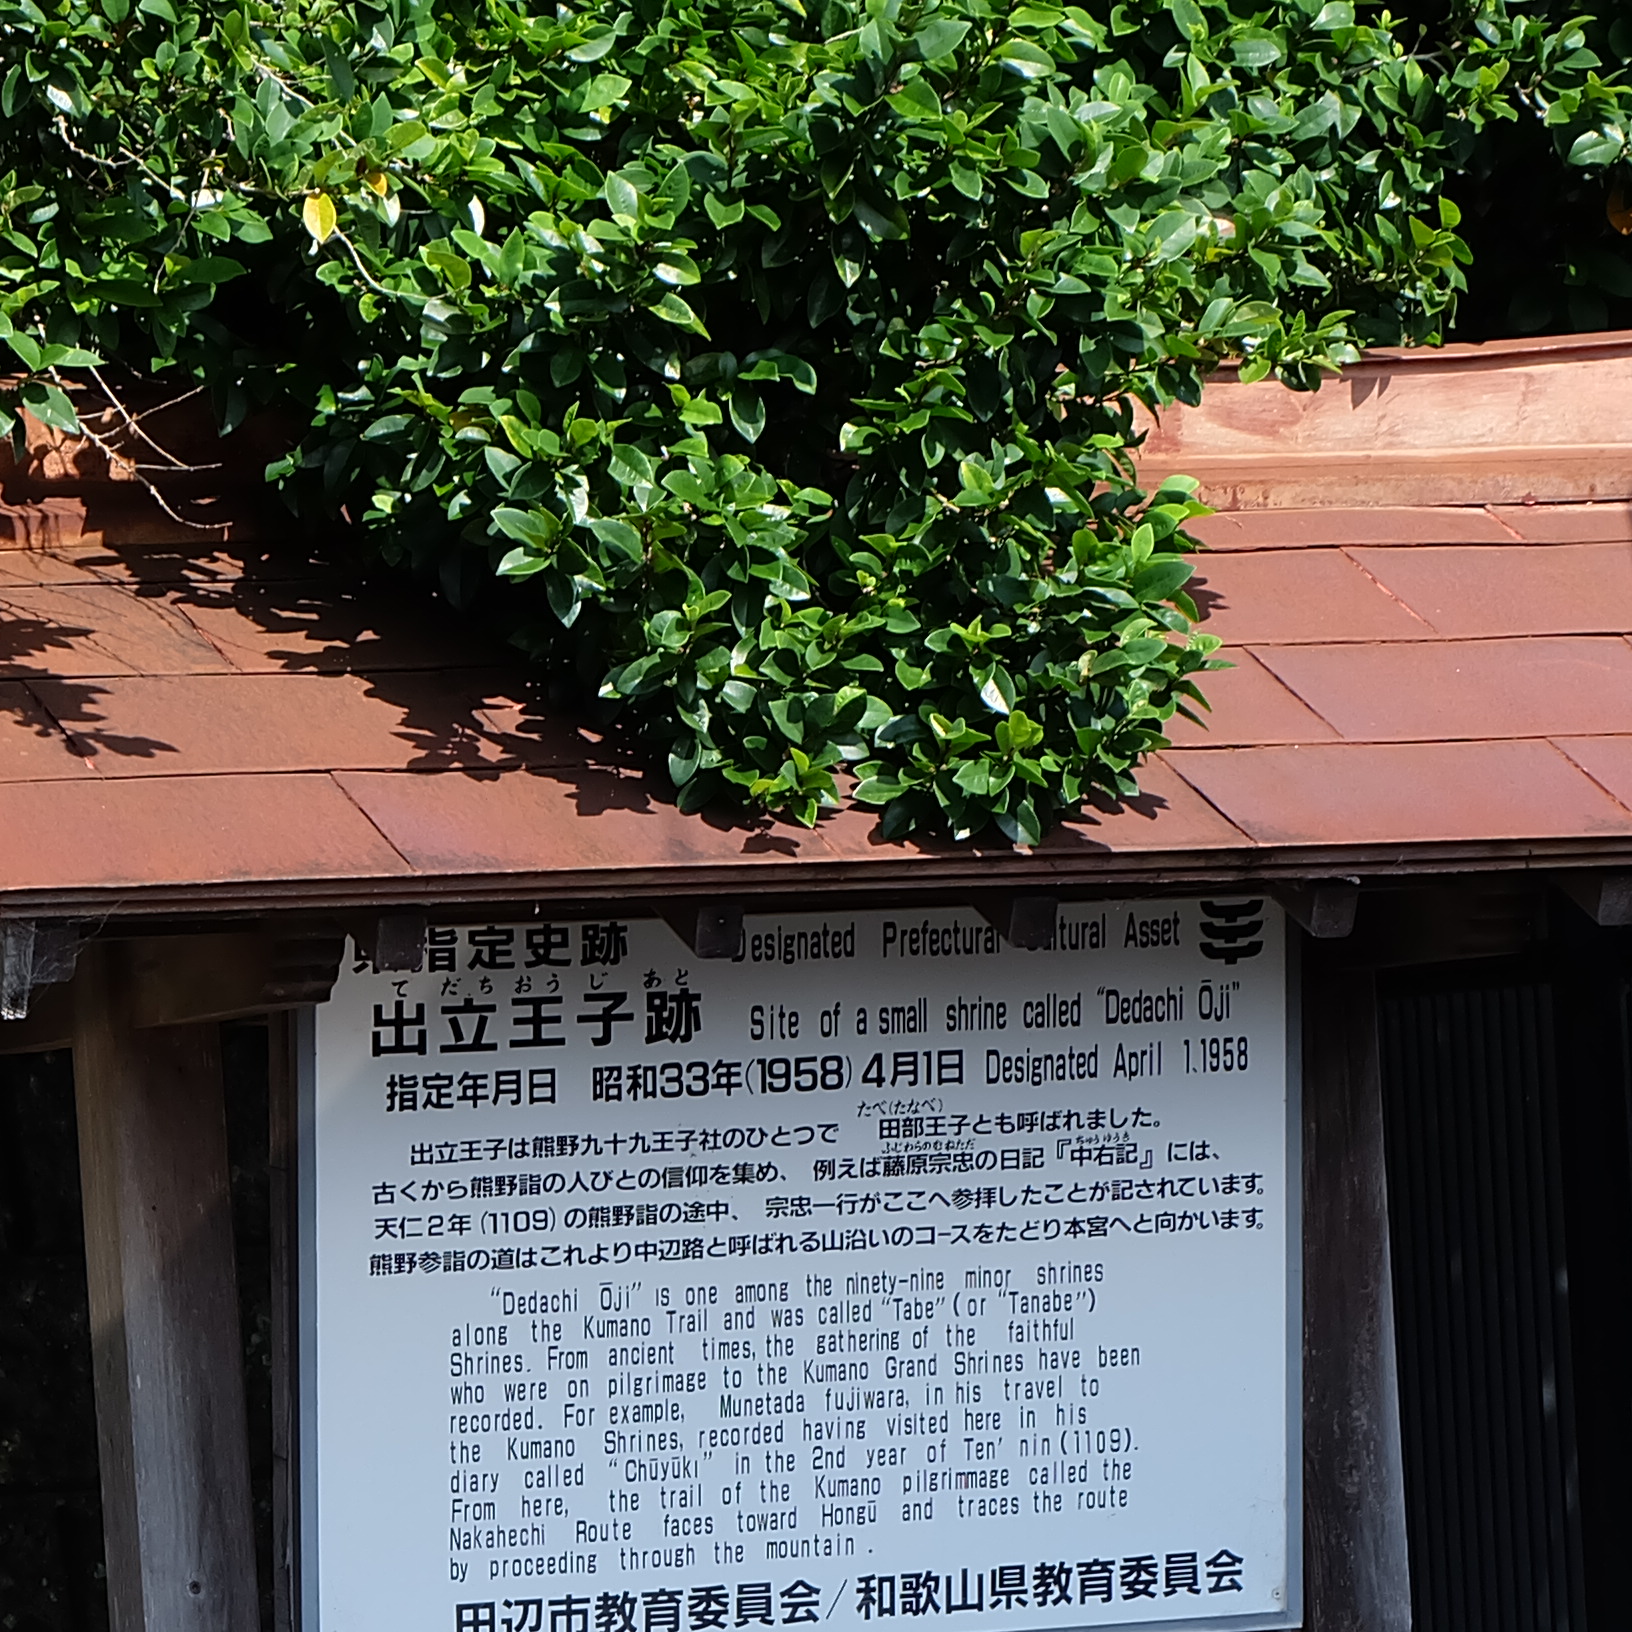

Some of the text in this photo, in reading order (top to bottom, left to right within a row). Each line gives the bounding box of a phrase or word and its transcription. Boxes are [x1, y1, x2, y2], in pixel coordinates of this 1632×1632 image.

[353, 921, 628, 974] 指定史跡
[1123, 909, 1181, 949] Asset
[371, 987, 702, 1058] 出立王子跡
[750, 1003, 800, 1041] Site
[819, 1001, 841, 1039] of
[855, 1006, 868, 1036] a
[878, 996, 928, 1036] small
[945, 994, 1008, 1033] shrine
[1022, 991, 1082, 1029] called
[385, 1067, 557, 1113] 指定年月日
[985, 1043, 1099, 1087] Designated
[1112, 1040, 1162, 1083] April
[685, 1285, 718, 1307] one
[734, 1281, 789, 1304] among
[805, 1273, 833, 1298] the
[846, 1267, 945, 1297] ninety-nine
[964, 1264, 1013, 1289] minor
[1036, 1260, 1104, 1286] shrines
[450, 1316, 1074, 1378] Shrines. From ancient times, the gathering of the faithful
[451, 1322, 508, 1348] along
[531, 1318, 562, 1344] the
[583, 1314, 651, 1340] Kumano
[665, 1307, 708, 1335] Trail
[723, 1304, 756, 1331] and
[770, 1307, 804, 1329] was
[817, 1297, 872, 1326] called
[450, 1344, 1140, 1406] who were on pilgrimage to the Kumano Grand Shrines have been
[450, 1405, 543, 1435] recorded.
[563, 1402, 596, 1429] For
[609, 1397, 685, 1426] example,
[719, 1388, 805, 1419] Munetada
[925, 1381, 944, 1407] in
[955, 1379, 982, 1405] his
[1003, 1374, 1063, 1402] travel
[1080, 1373, 1100, 1398] to
[449, 1402, 1087, 1465] the Kumano Shrines, recorded having visited here in his
[450, 1468, 500, 1494] diary
[524, 1462, 584, 1490] called
[735, 1451, 751, 1476] in
[764, 1449, 796, 1474] the
[811, 1444, 846, 1471] 2nd
[866, 1446, 907, 1470] year
[926, 1437, 947, 1464] of
[451, 1497, 496, 1524] From
[521, 1494, 569, 1519] here,
[608, 1488, 640, 1514] the
[659, 1482, 702, 1510] trail
[721, 1480, 742, 1506] of
[759, 1478, 790, 1504] the
[814, 1473, 881, 1500] Kumano
[1028, 1458, 1088, 1486] called
[1102, 1457, 1132, 1482] the
[449, 1484, 1128, 1552] Nakahechi Route faces toward Hongū and traces the route
[449, 1556, 469, 1584] by
[489, 1550, 598, 1581] proceeding
[619, 1541, 696, 1571] through
[713, 1540, 744, 1565] the
